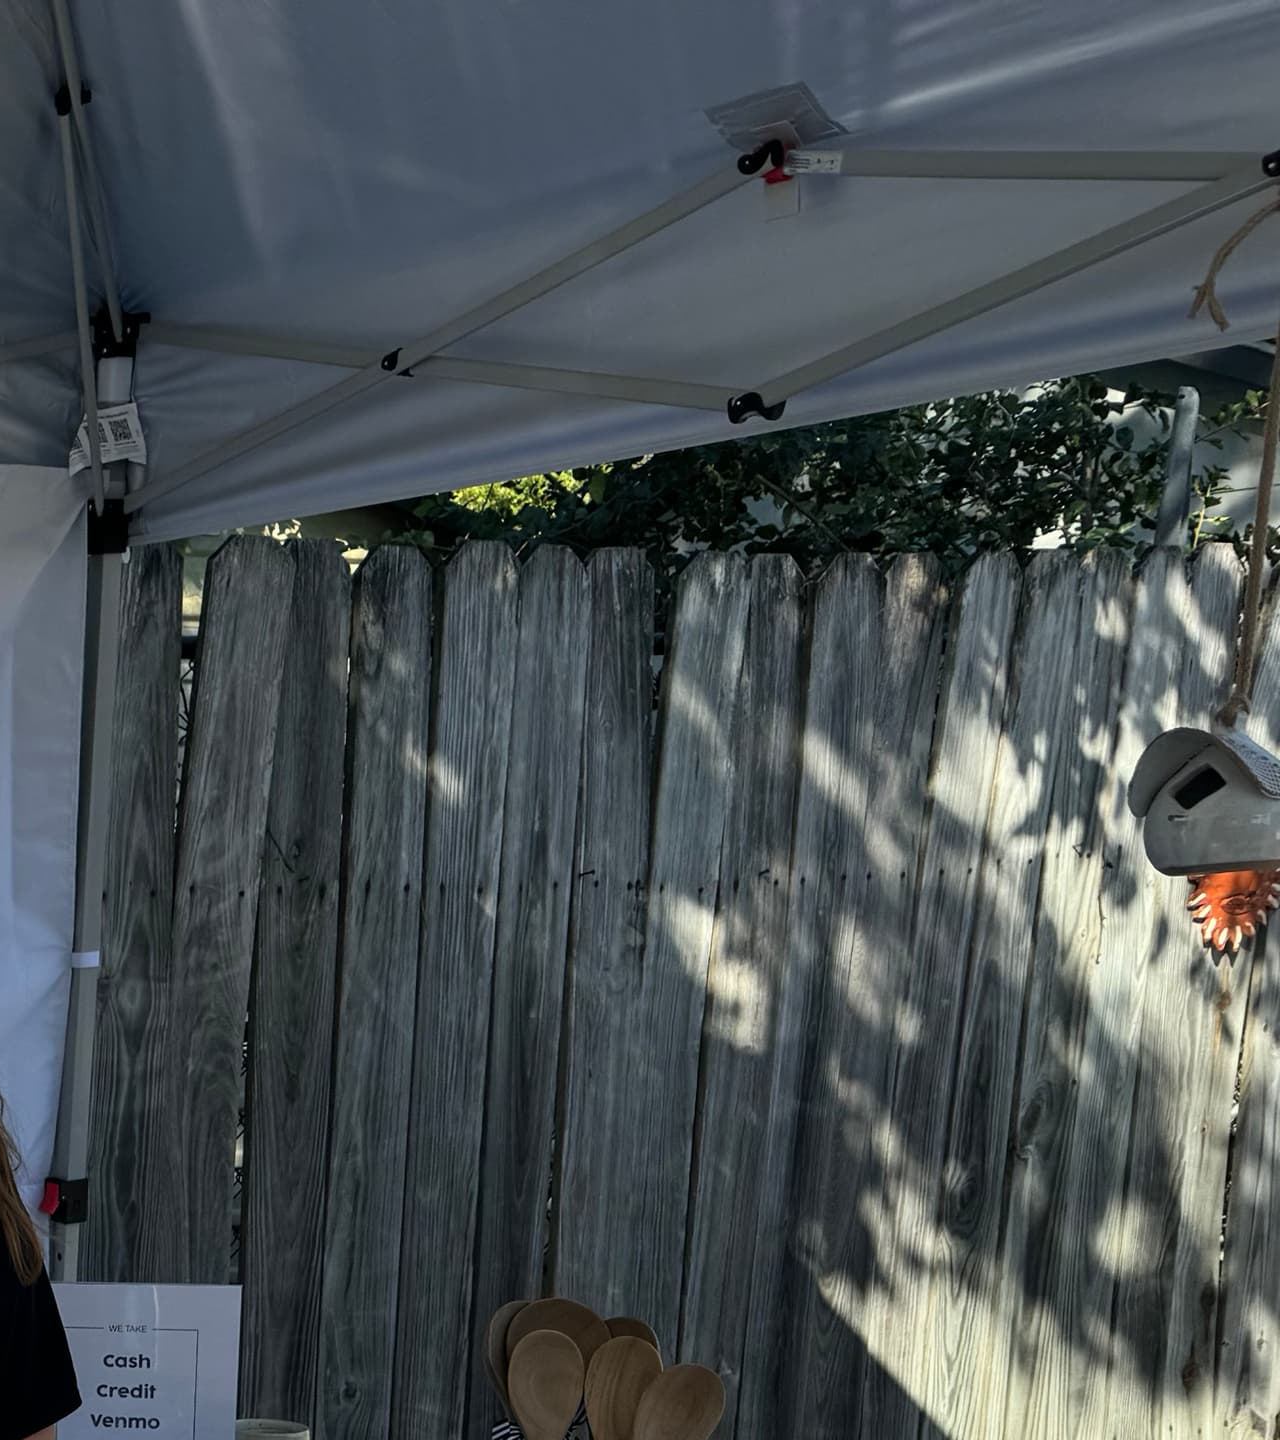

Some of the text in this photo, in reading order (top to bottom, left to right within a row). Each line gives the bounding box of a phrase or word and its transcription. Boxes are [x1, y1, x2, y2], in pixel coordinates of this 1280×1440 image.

[108, 1325, 148, 1333] WE TAKE
[103, 1353, 151, 1369] Cash
[96, 1384, 157, 1399] Credit
[90, 1413, 161, 1430] Venmo
